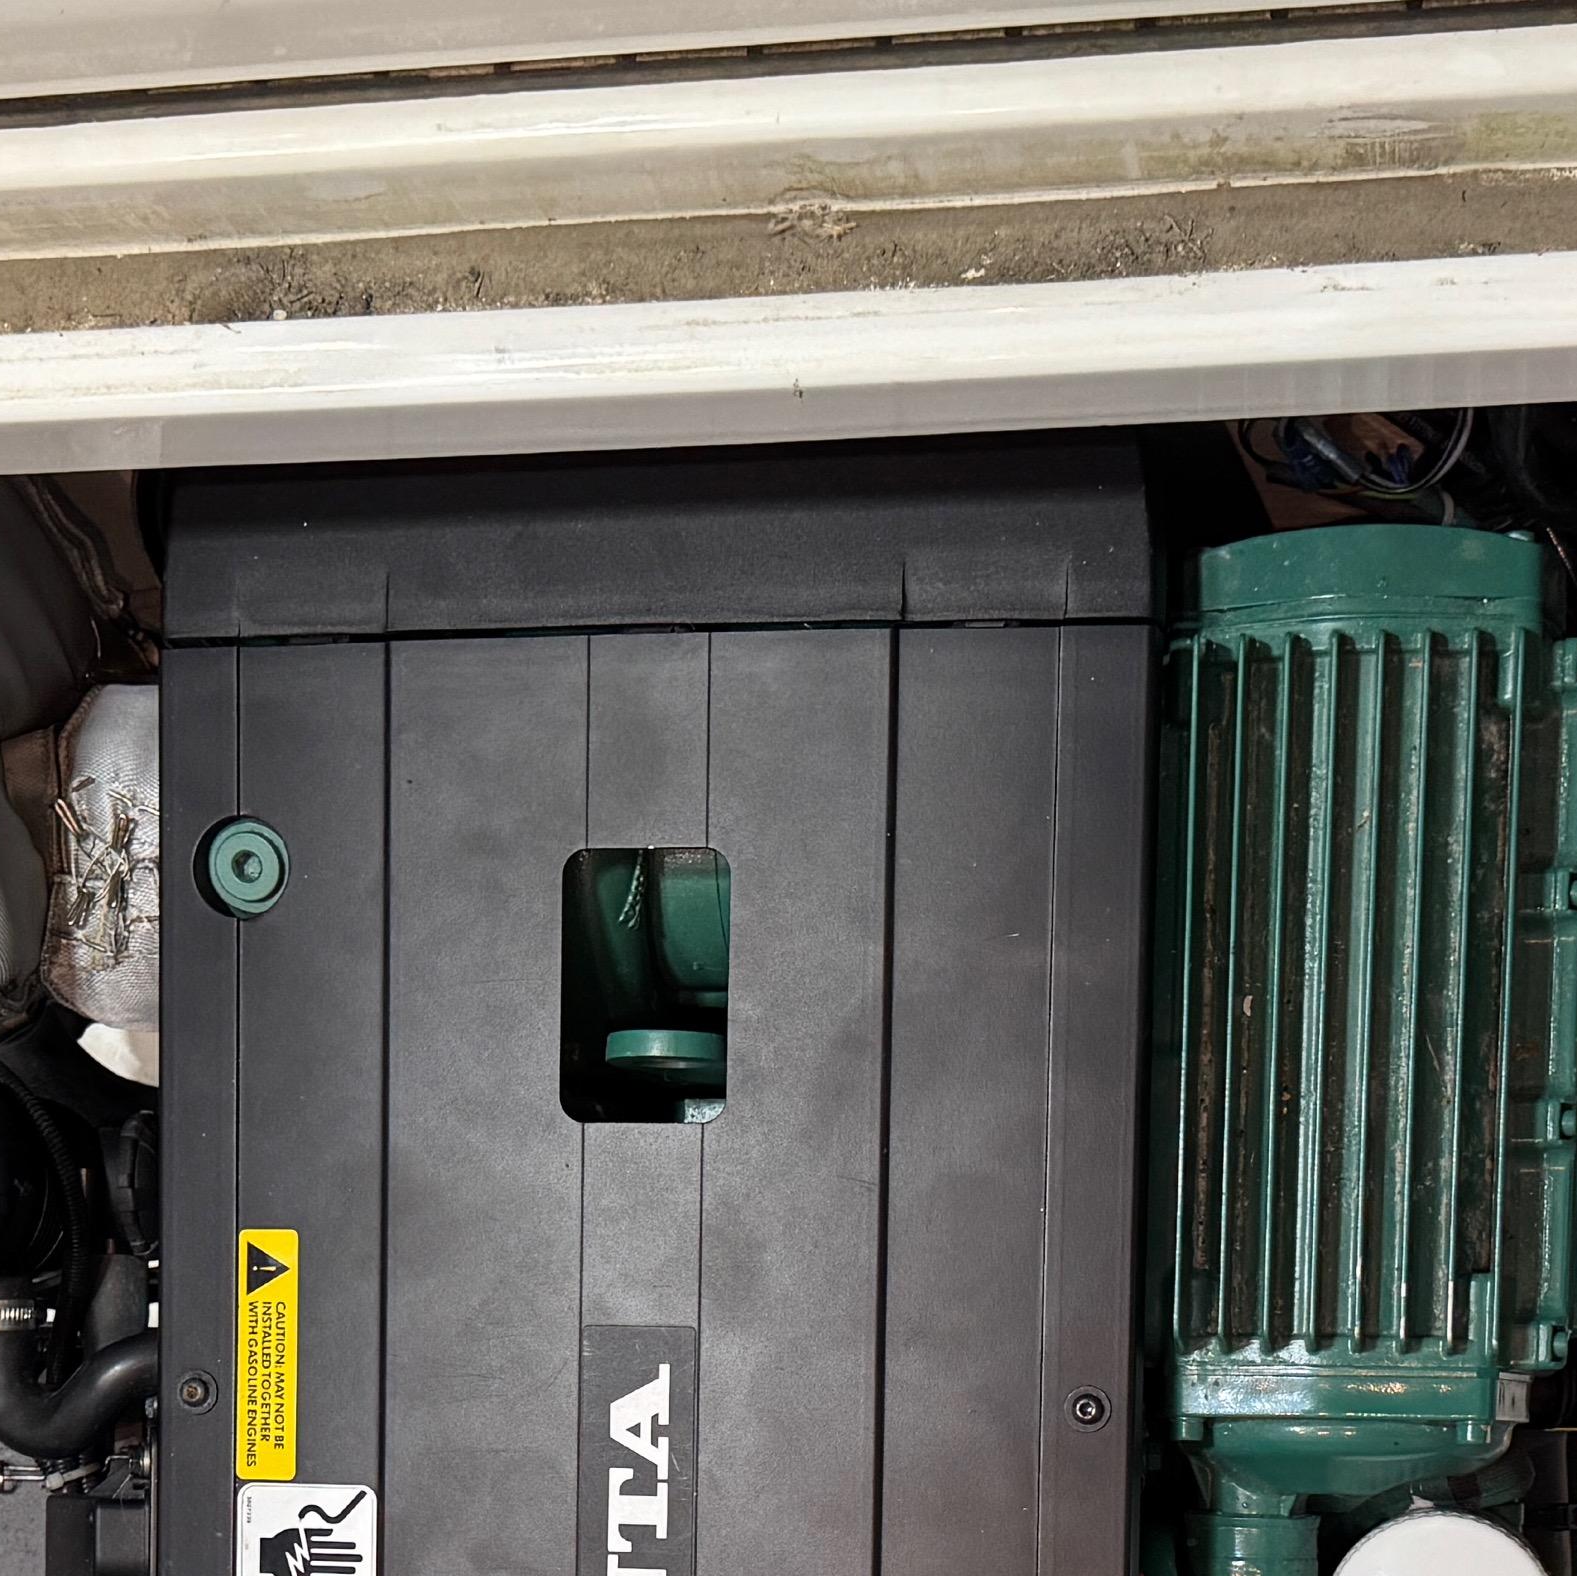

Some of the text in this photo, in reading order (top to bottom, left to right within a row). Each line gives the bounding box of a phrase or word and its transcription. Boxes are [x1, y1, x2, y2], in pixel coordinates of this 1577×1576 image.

[246, 1301, 259, 1467] WITH GASOLINE ENGINES
[260, 1301, 272, 1442] INSTALLED TOGETHER
[274, 1301, 286, 1449] CAUTION: MAY NOT BE
